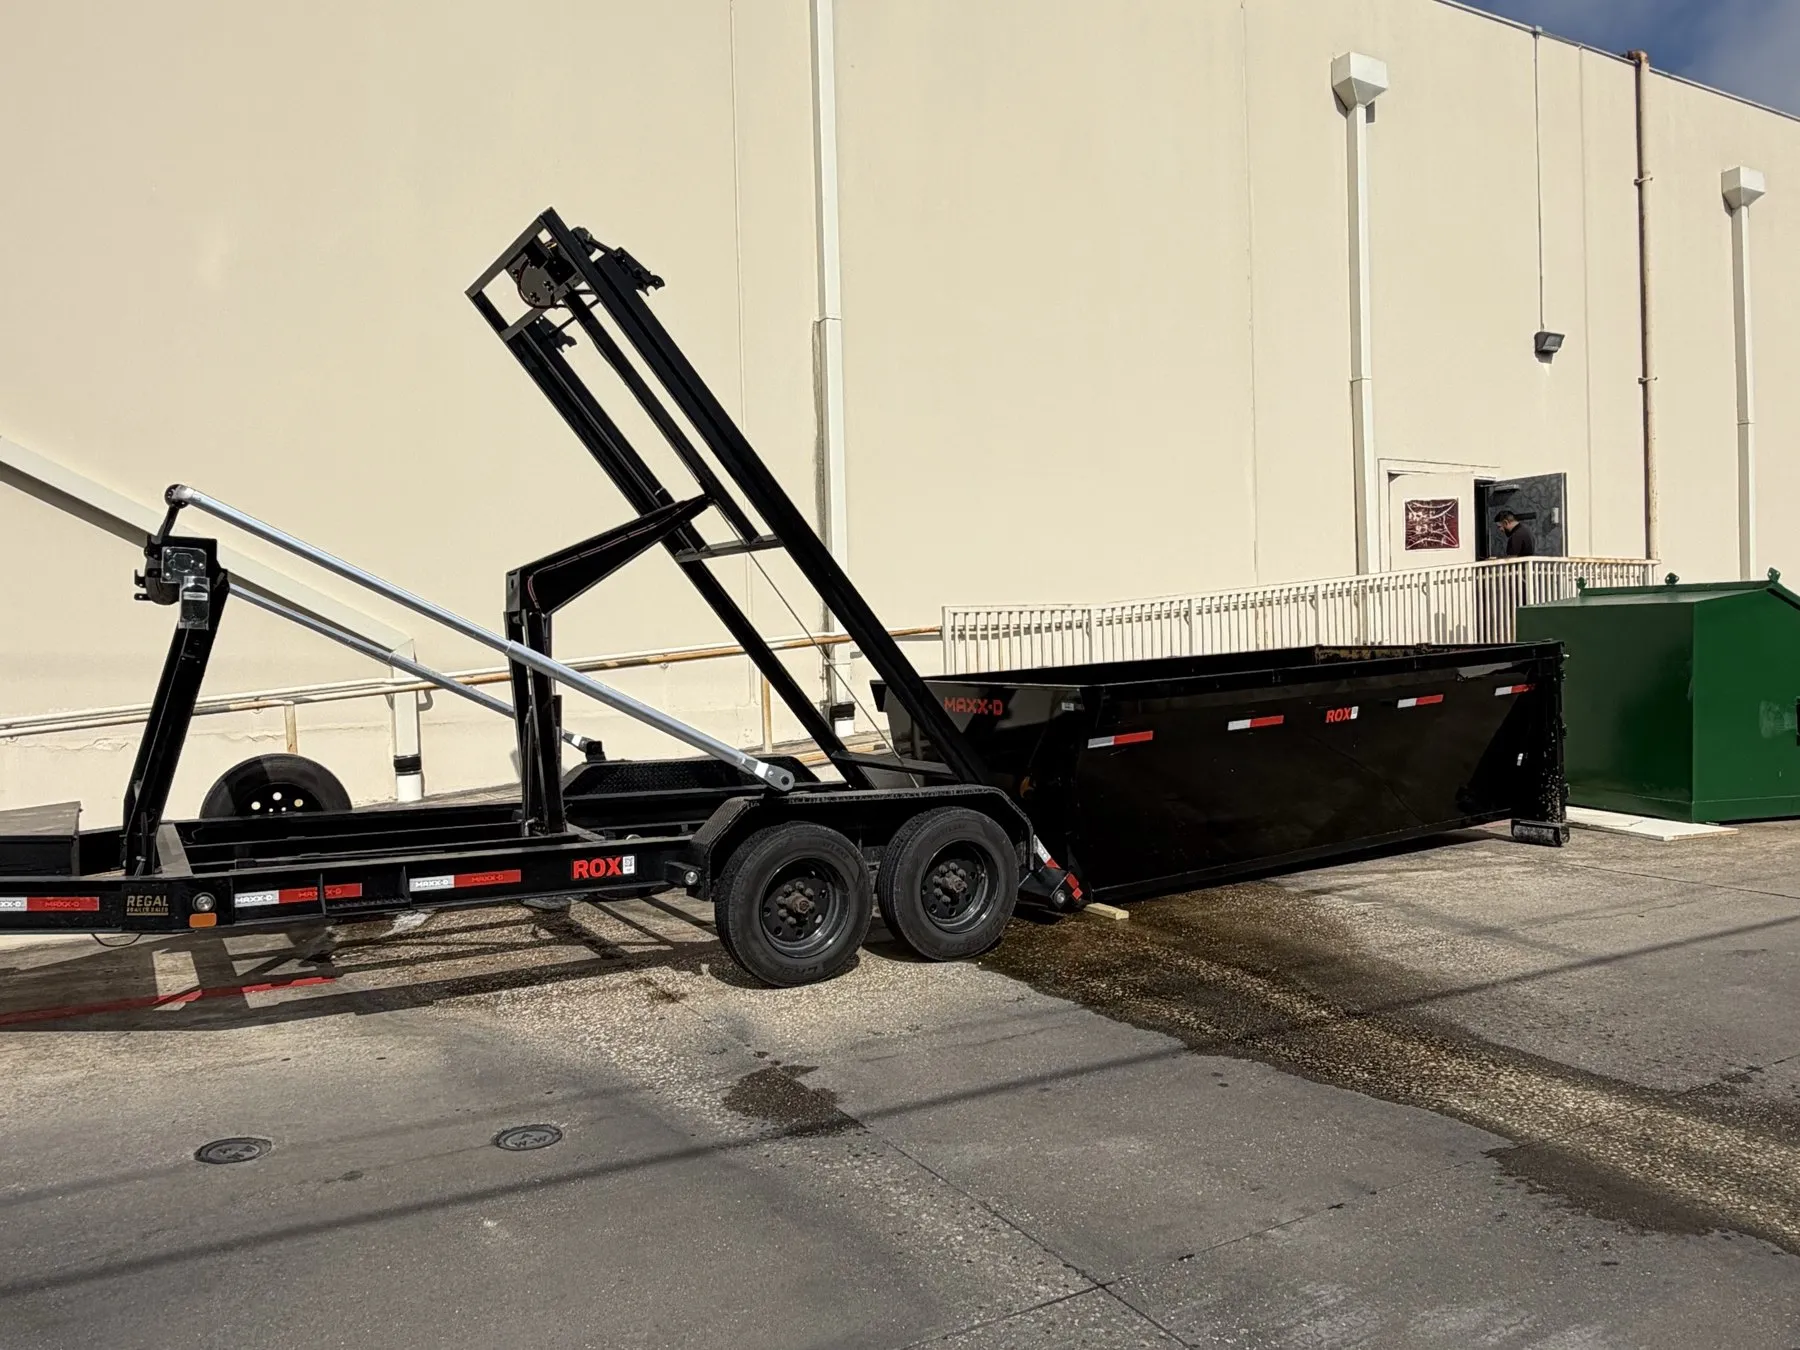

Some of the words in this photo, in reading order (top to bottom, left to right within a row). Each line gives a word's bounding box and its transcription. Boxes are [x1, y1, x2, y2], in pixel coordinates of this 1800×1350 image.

[1325, 707, 1351, 723] ROX
[573, 857, 622, 879] ROX
[126, 895, 169, 907] REGAL
